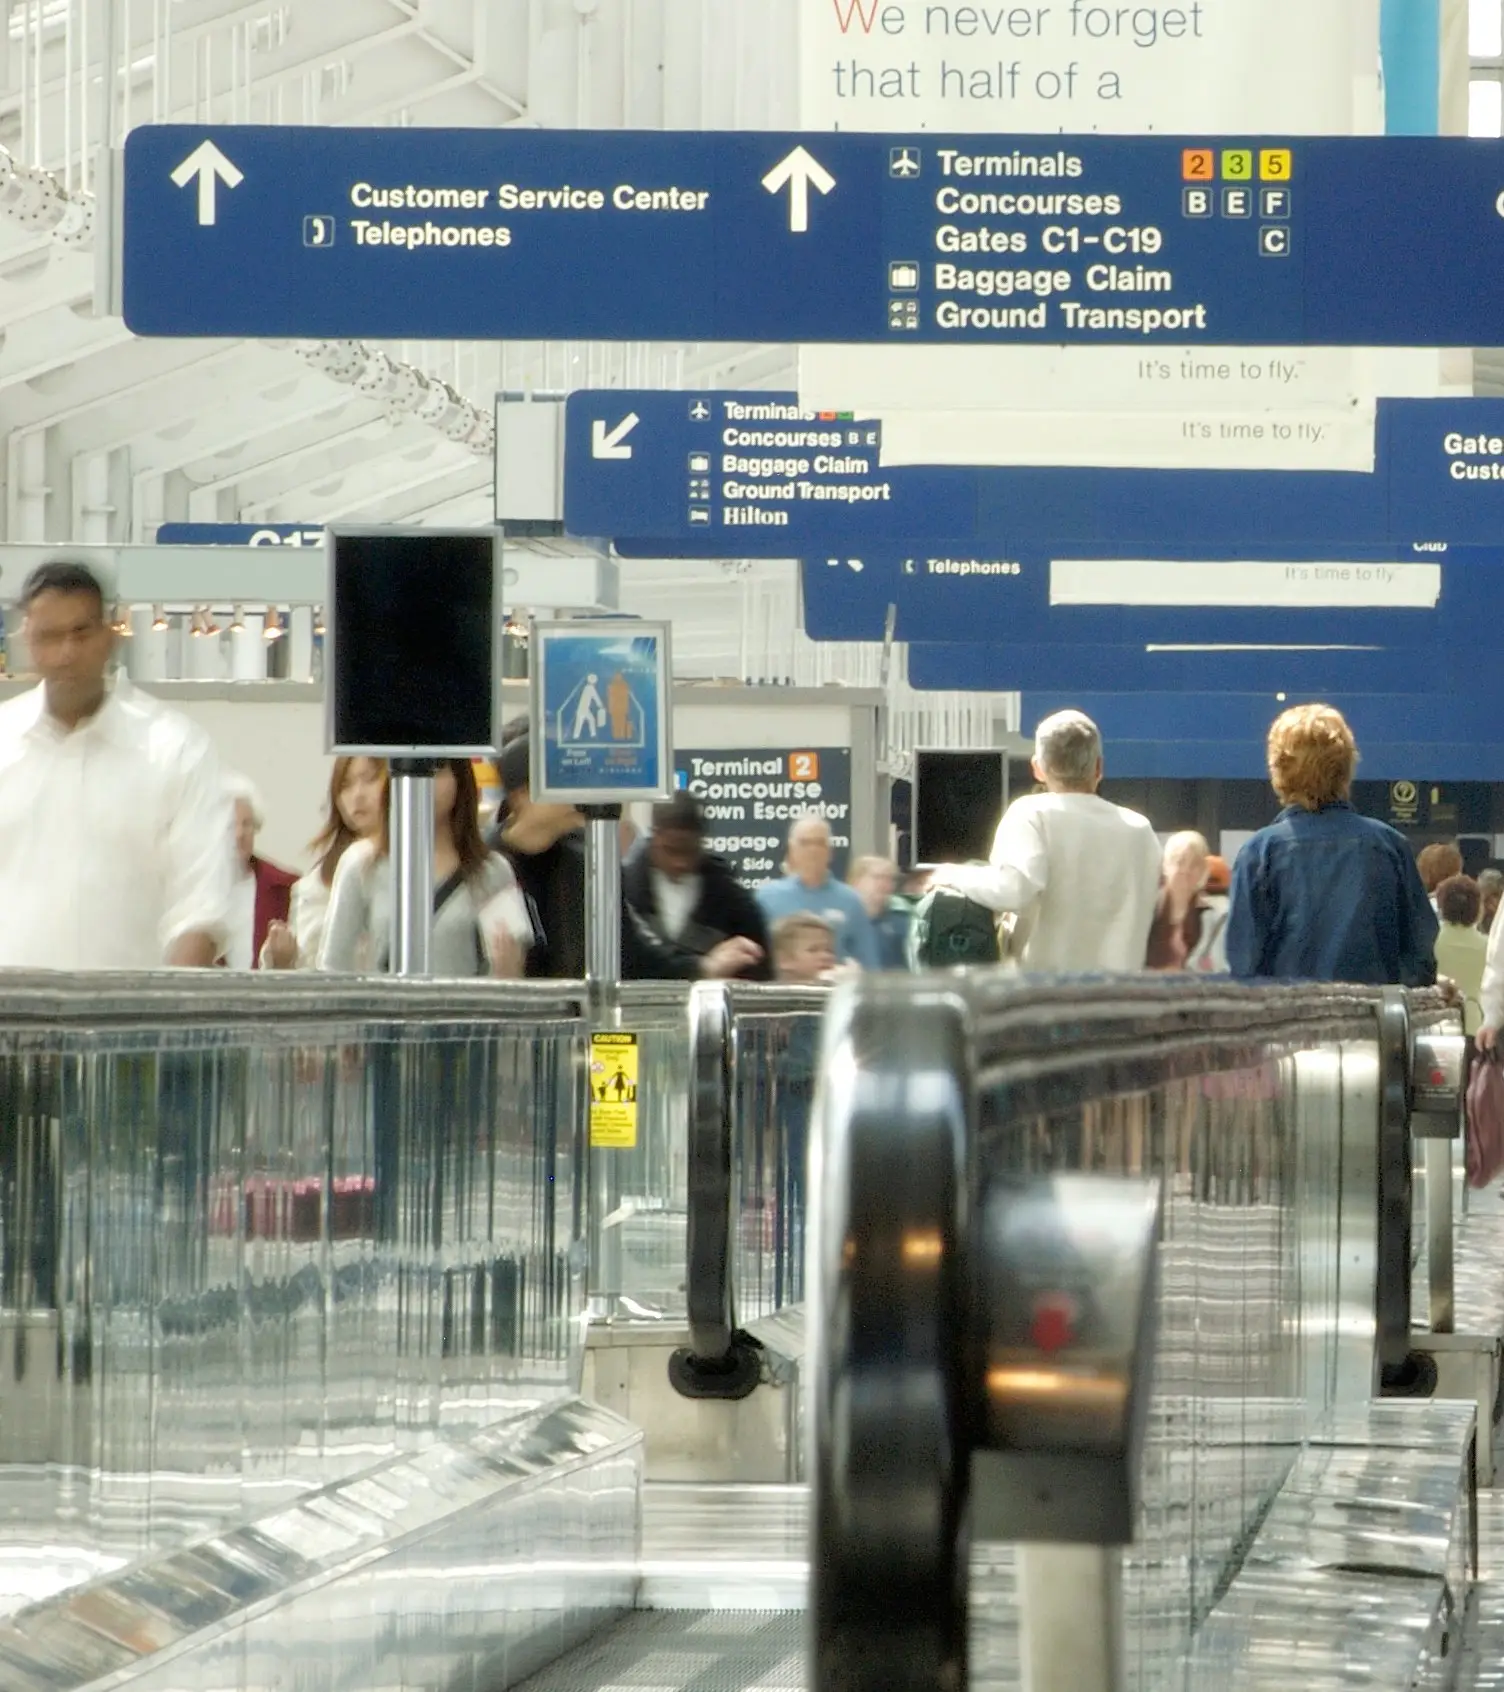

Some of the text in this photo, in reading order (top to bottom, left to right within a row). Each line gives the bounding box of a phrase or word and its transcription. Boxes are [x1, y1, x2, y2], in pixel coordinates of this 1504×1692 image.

[834, 0, 1203, 47] We never forget
[832, 60, 1123, 99] that half of a
[937, 150, 1282, 178] Terminals 2 3 5
[350, 183, 709, 211] Customer Service Center
[936, 188, 1283, 216] Concourses B E F
[351, 221, 511, 250] Telephones
[936, 225, 1283, 254] Gates C1-C19 C
[936, 264, 1172, 296] Baggage Claim
[936, 301, 1207, 333] Ground Transport
[1138, 360, 1170, 380] It's
[1180, 360, 1231, 380] time
[1240, 361, 1262, 380] to
[723, 427, 877, 448] Concourses B E
[1220, 422, 1264, 439] time
[1272, 423, 1292, 439] to
[723, 455, 869, 477] Baggage Claim
[723, 481, 890, 503] Ground Transport
[723, 506, 789, 526] Hilton
[927, 559, 1021, 576] Telephones
[1314, 567, 1350, 580] time
[1356, 567, 1372, 580] to
[691, 755, 811, 777] Terminal 2
[689, 779, 822, 800] Concourse
[702, 801, 849, 820] own Escalator
[702, 836, 780, 852] aggage
[742, 857, 774, 871] Side
